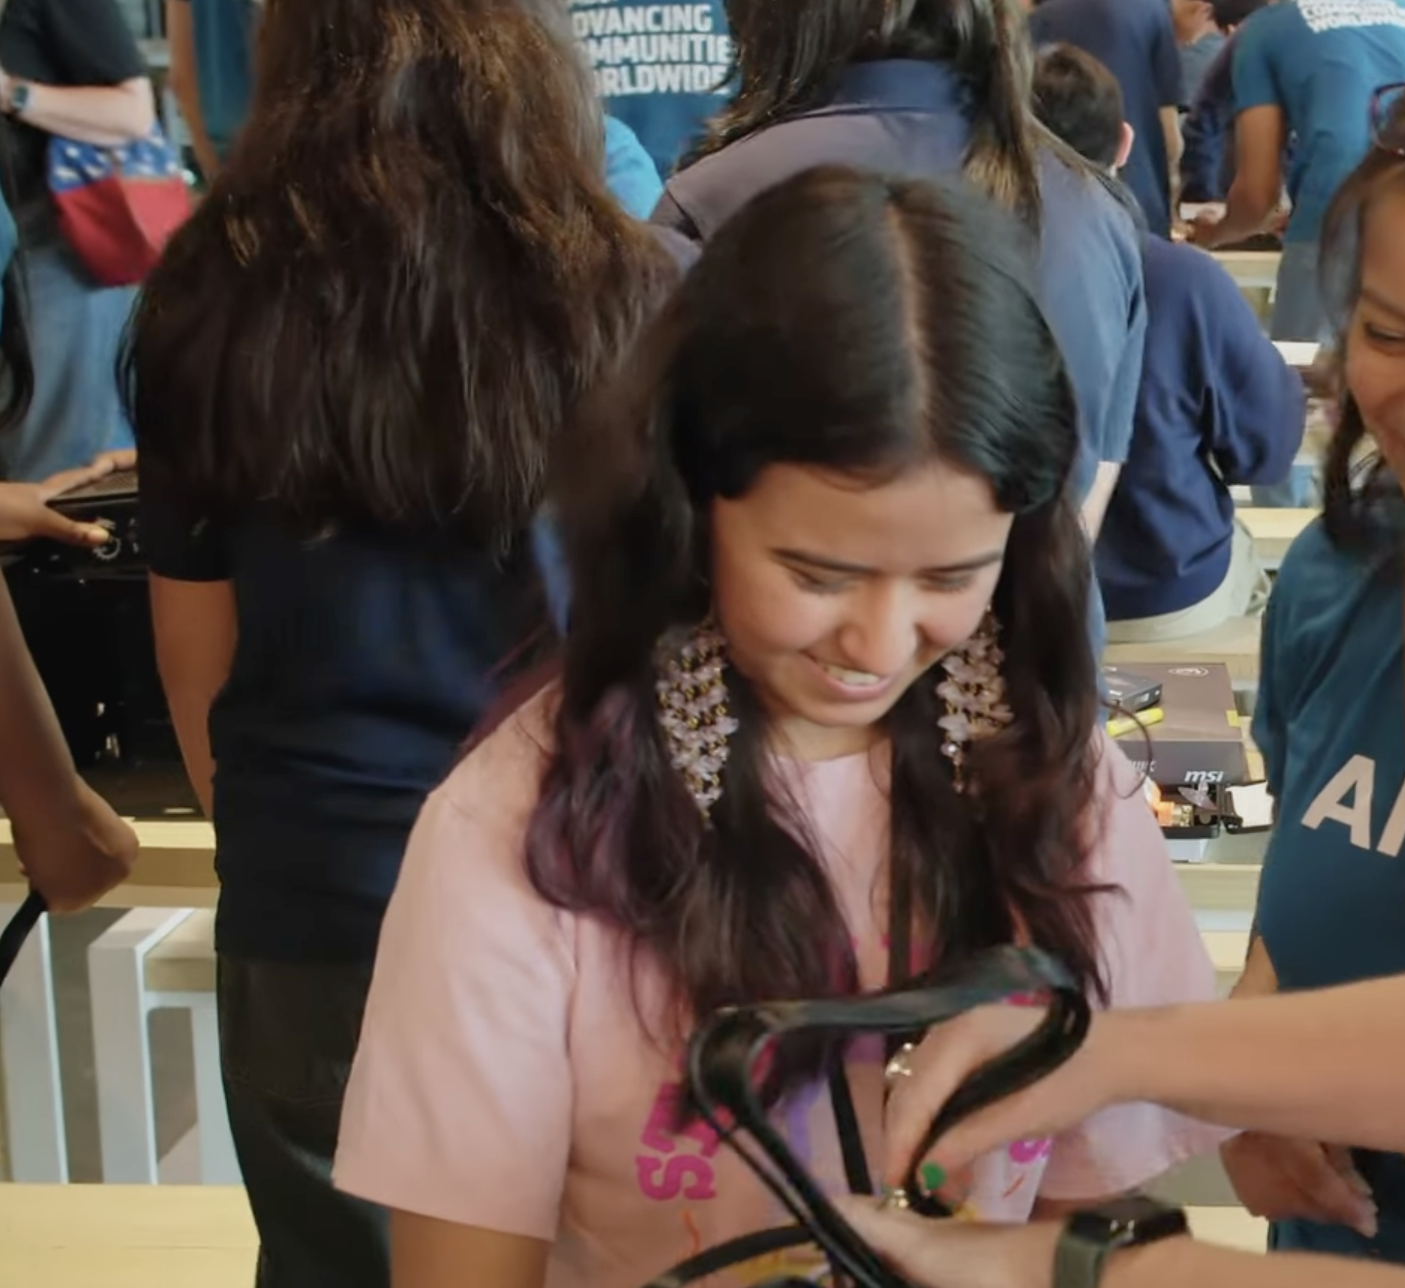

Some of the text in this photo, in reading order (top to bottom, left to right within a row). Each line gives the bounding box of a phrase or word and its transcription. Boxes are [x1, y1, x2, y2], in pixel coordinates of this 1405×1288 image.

[571, 4, 713, 37] DVANCING
[582, 33, 737, 66] MMUNITIE
[594, 62, 732, 98] RLDWIDE
[1184, 770, 1225, 783] msi
